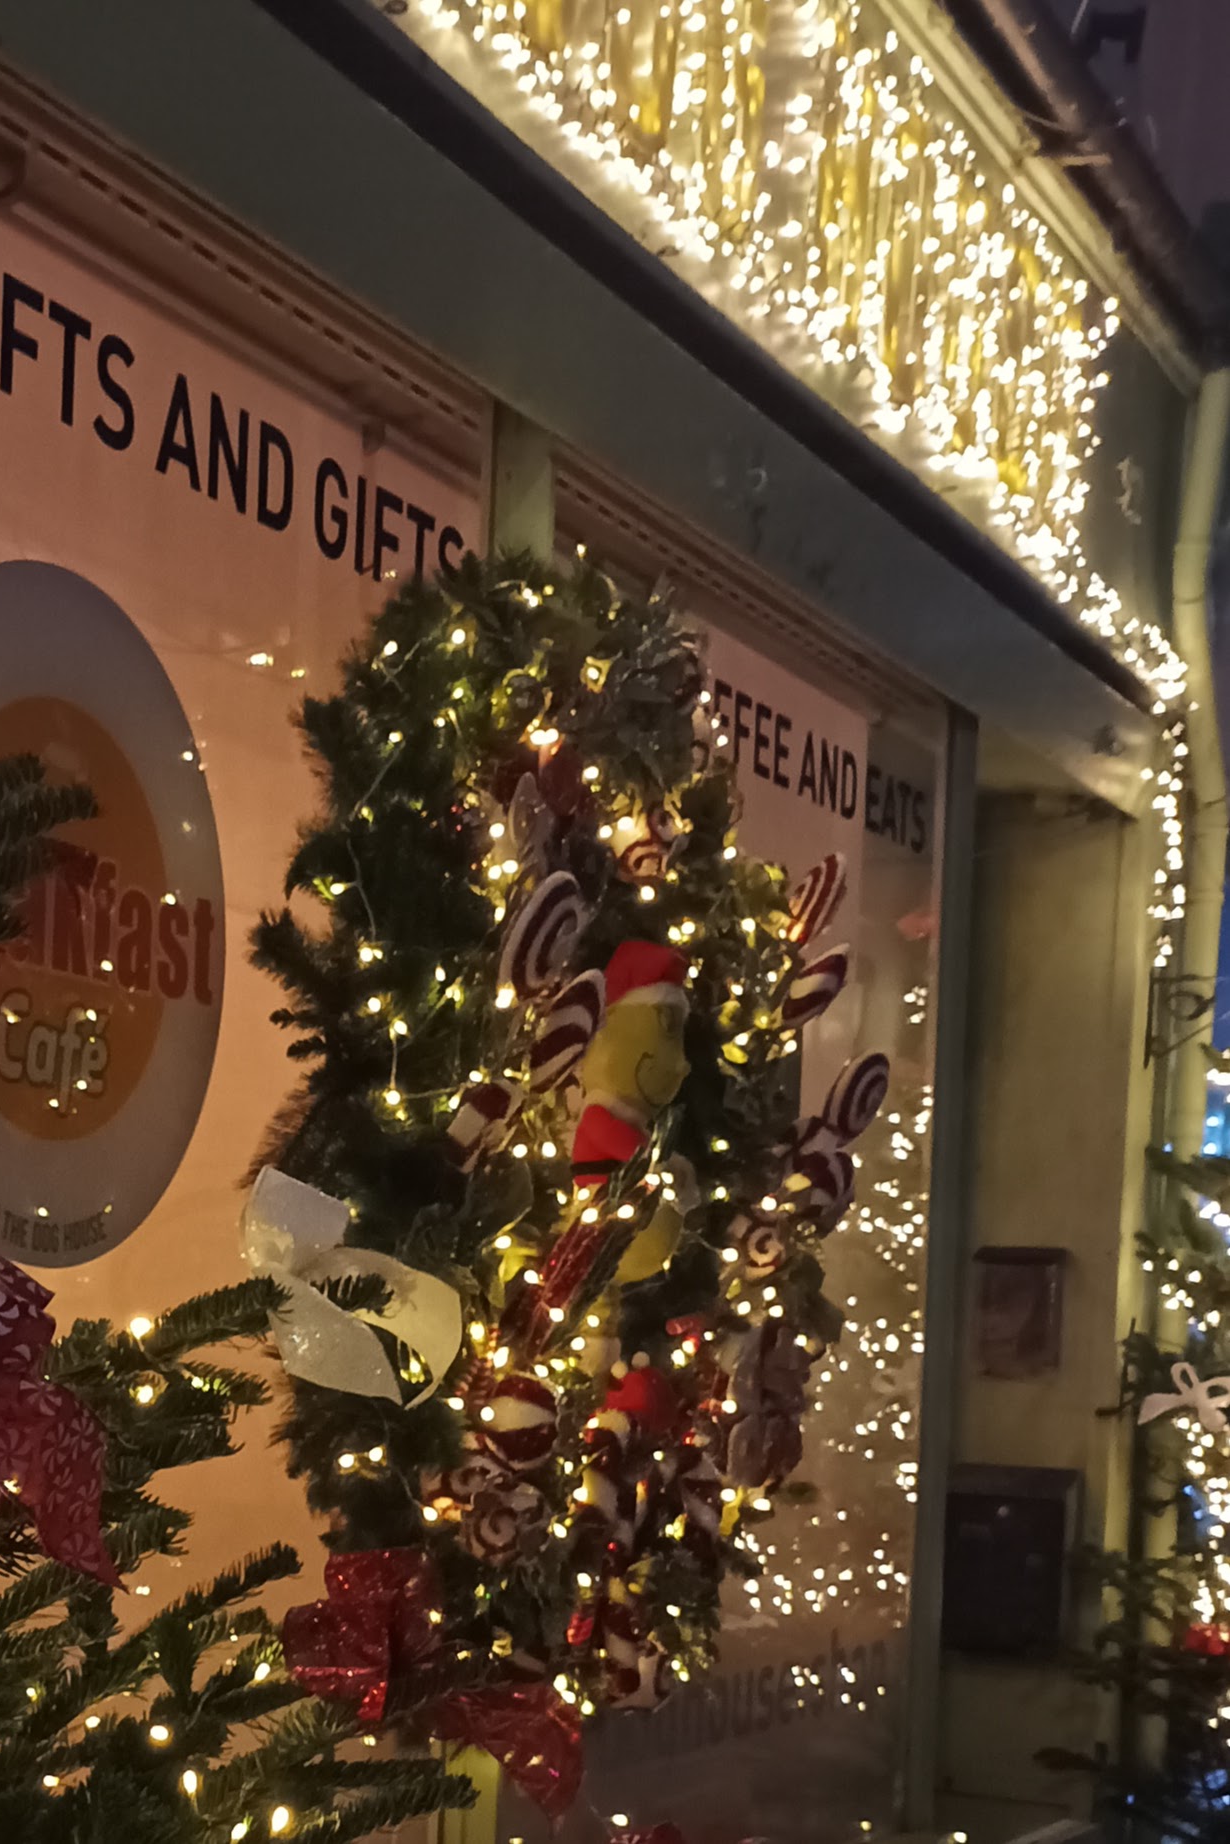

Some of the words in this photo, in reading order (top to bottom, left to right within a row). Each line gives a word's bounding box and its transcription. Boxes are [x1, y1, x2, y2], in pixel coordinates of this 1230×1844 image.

[155, 373, 294, 531] AND
[314, 457, 465, 583] GIFTS
[712, 678, 792, 789] FFEE
[797, 730, 858, 820] AND
[865, 764, 926, 854] EATS
[1, 1210, 29, 1249] THE
[31, 1219, 60, 1254] DOG
[63, 1210, 106, 1252] HOUSE
